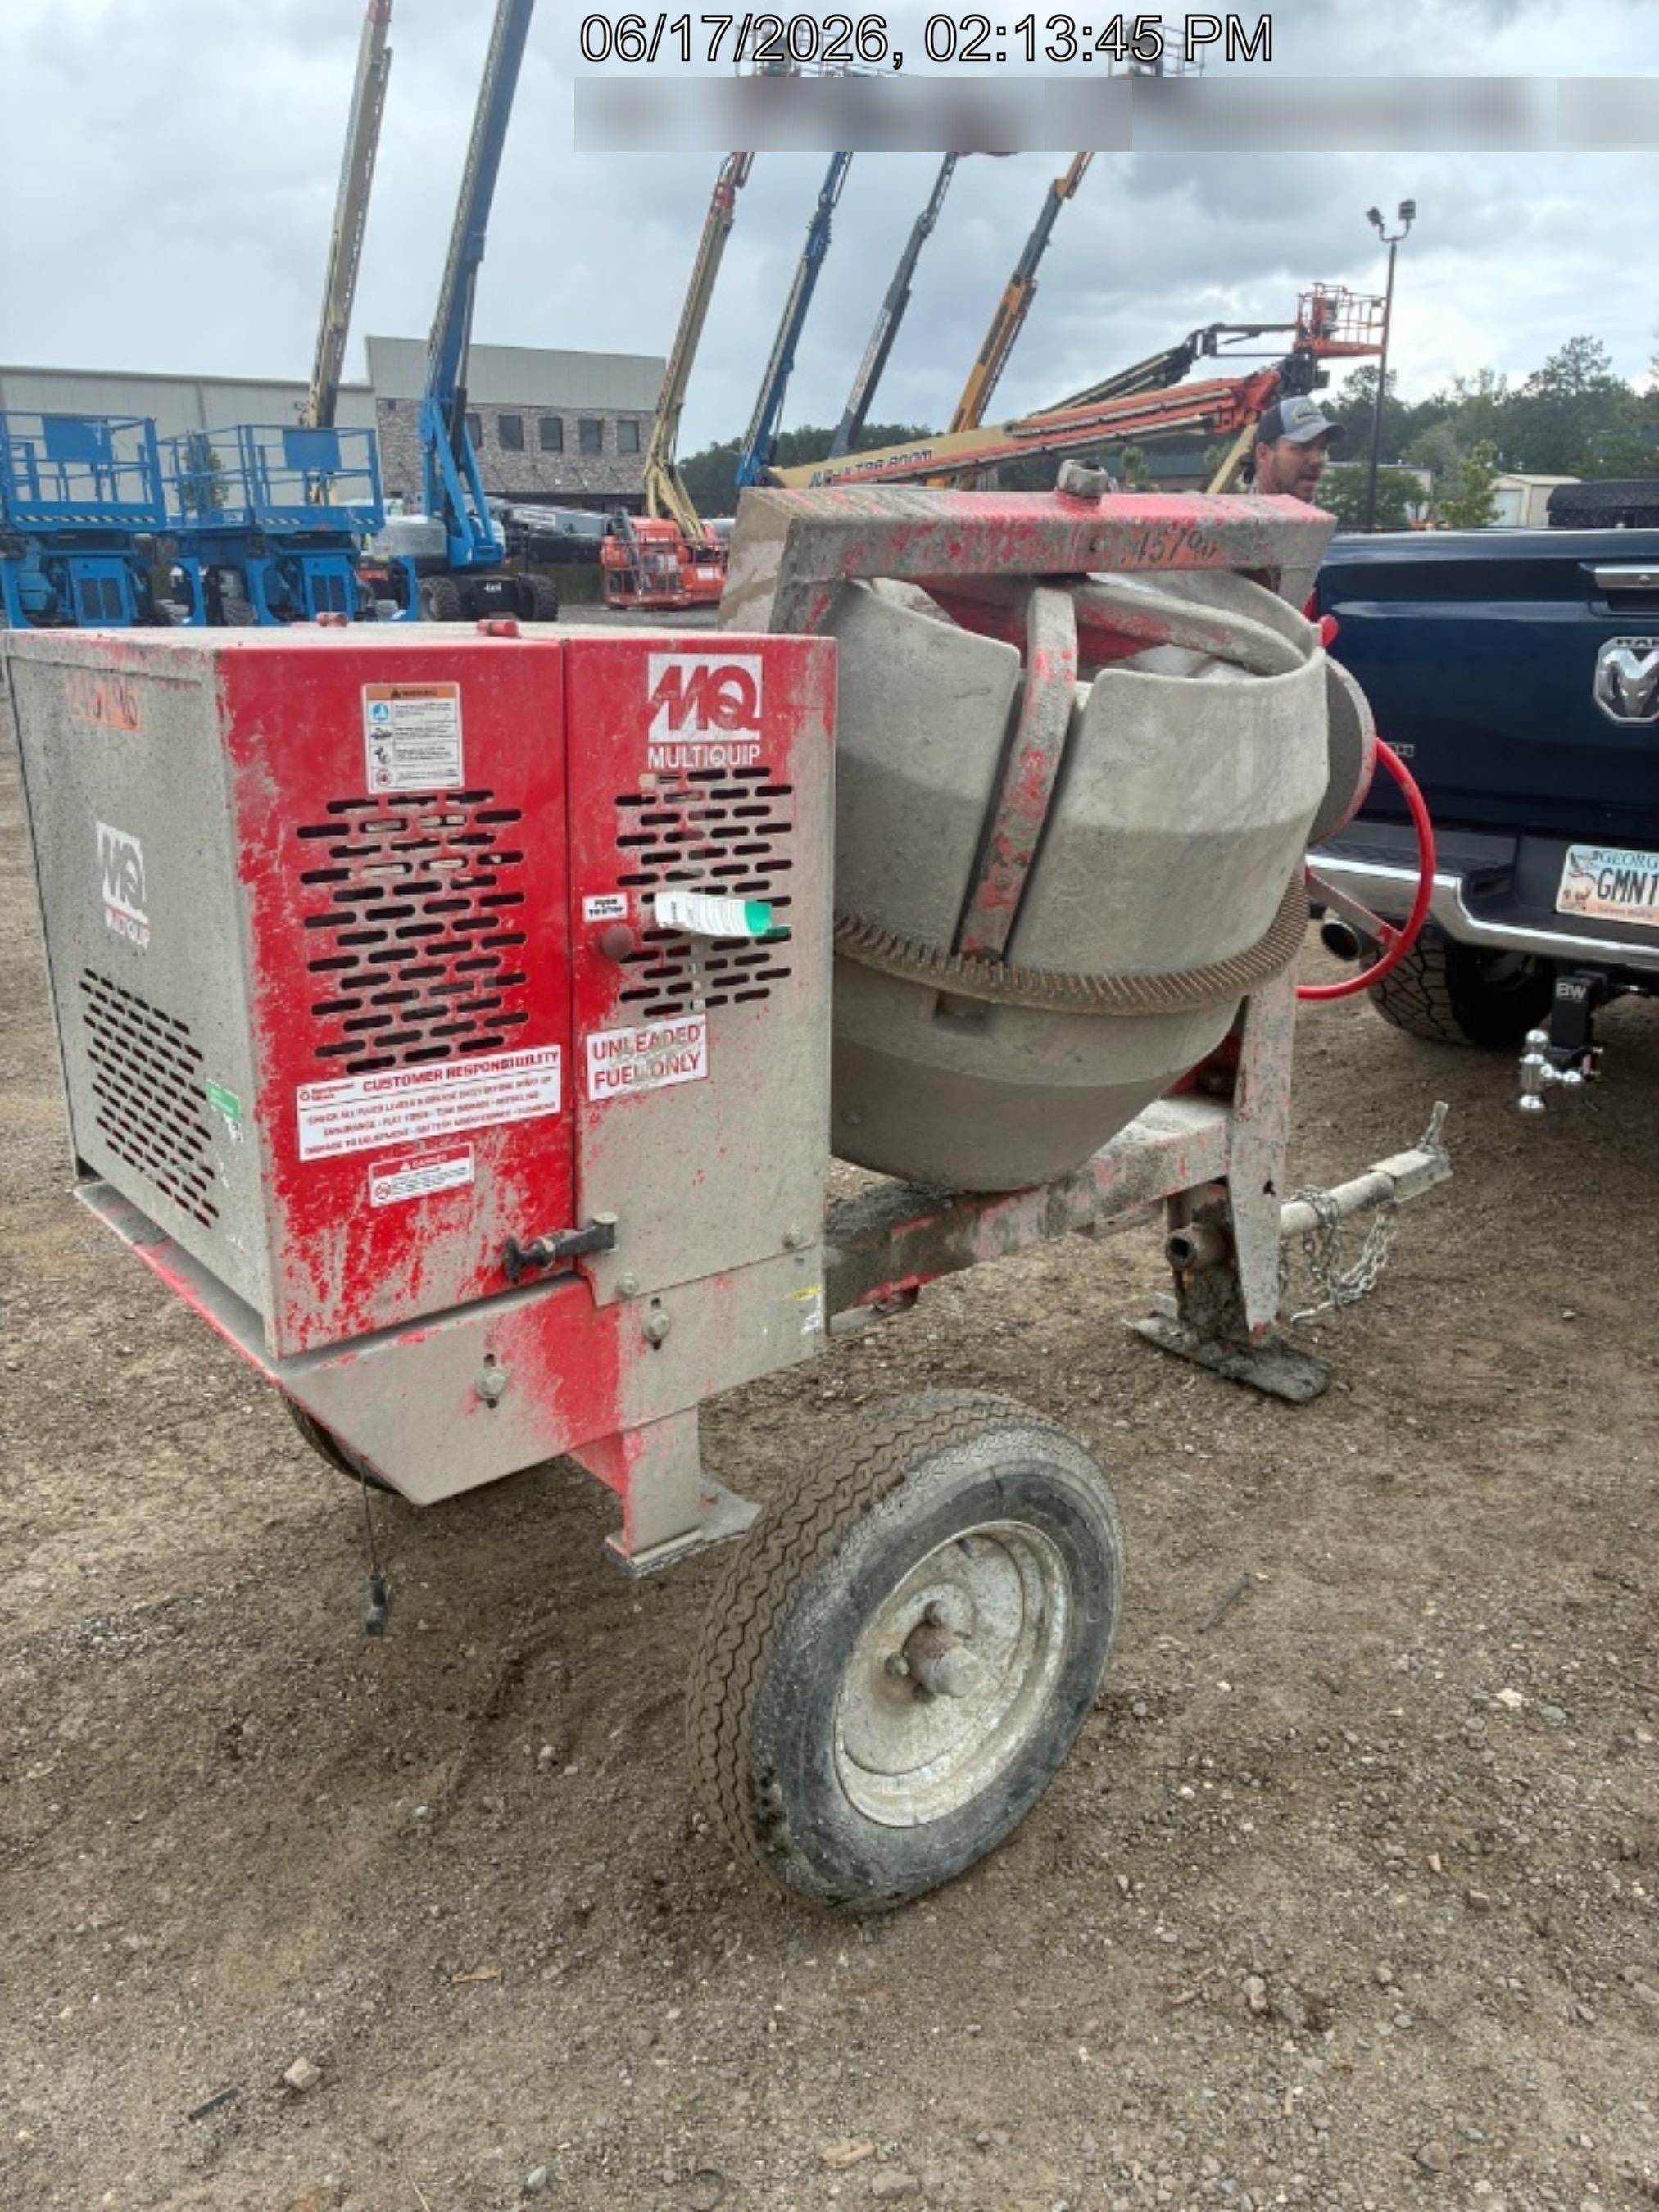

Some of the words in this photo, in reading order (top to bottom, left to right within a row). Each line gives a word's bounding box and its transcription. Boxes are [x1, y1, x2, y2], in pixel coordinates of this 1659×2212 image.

[647, 660, 762, 733] MQ
[646, 744, 761, 769] MULTIQUIP
[592, 1023, 701, 1061] UNLEADED
[363, 1068, 443, 1092] CUSTOMER
[593, 1064, 644, 1090] FUEL
[651, 1051, 701, 1078] ONLY
